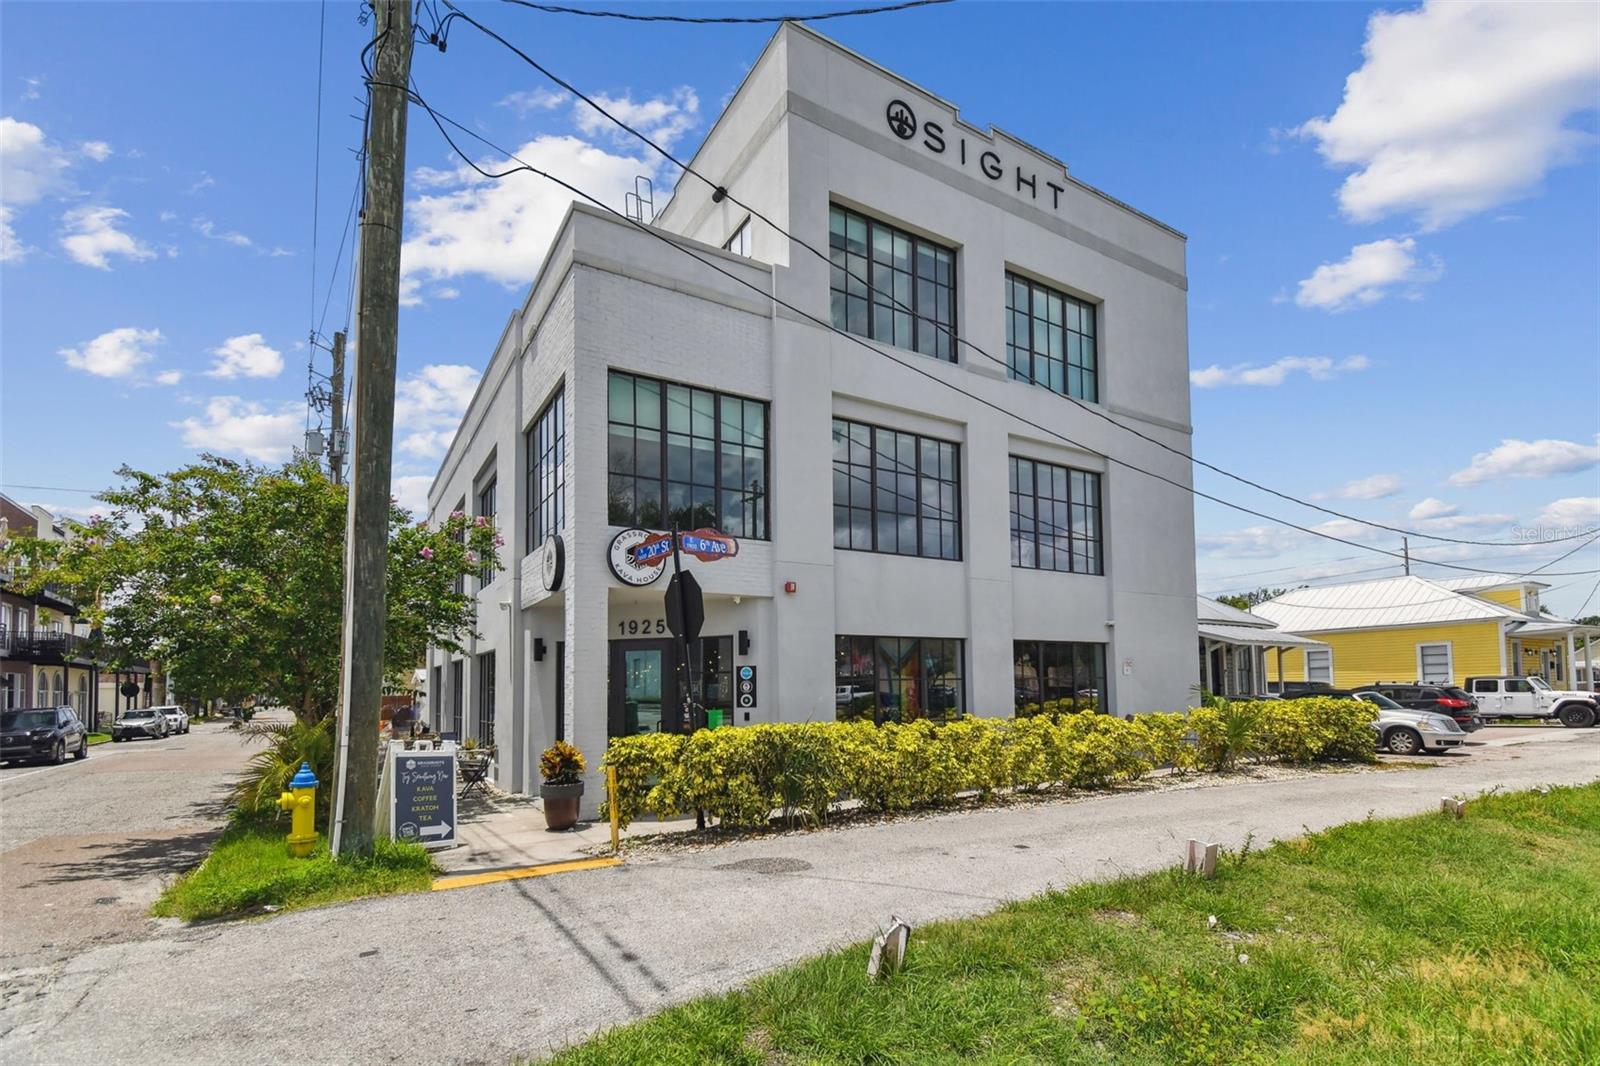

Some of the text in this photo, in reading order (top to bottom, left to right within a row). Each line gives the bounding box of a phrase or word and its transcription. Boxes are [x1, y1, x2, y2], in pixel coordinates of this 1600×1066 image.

[923, 121, 1065, 209] SIGHT
[614, 531, 648, 551] GRASSRO
[661, 540, 670, 553] St
[711, 541, 727, 553] Ave
[615, 563, 661, 583] KAVA HOUSE
[618, 619, 666, 635] 1925
